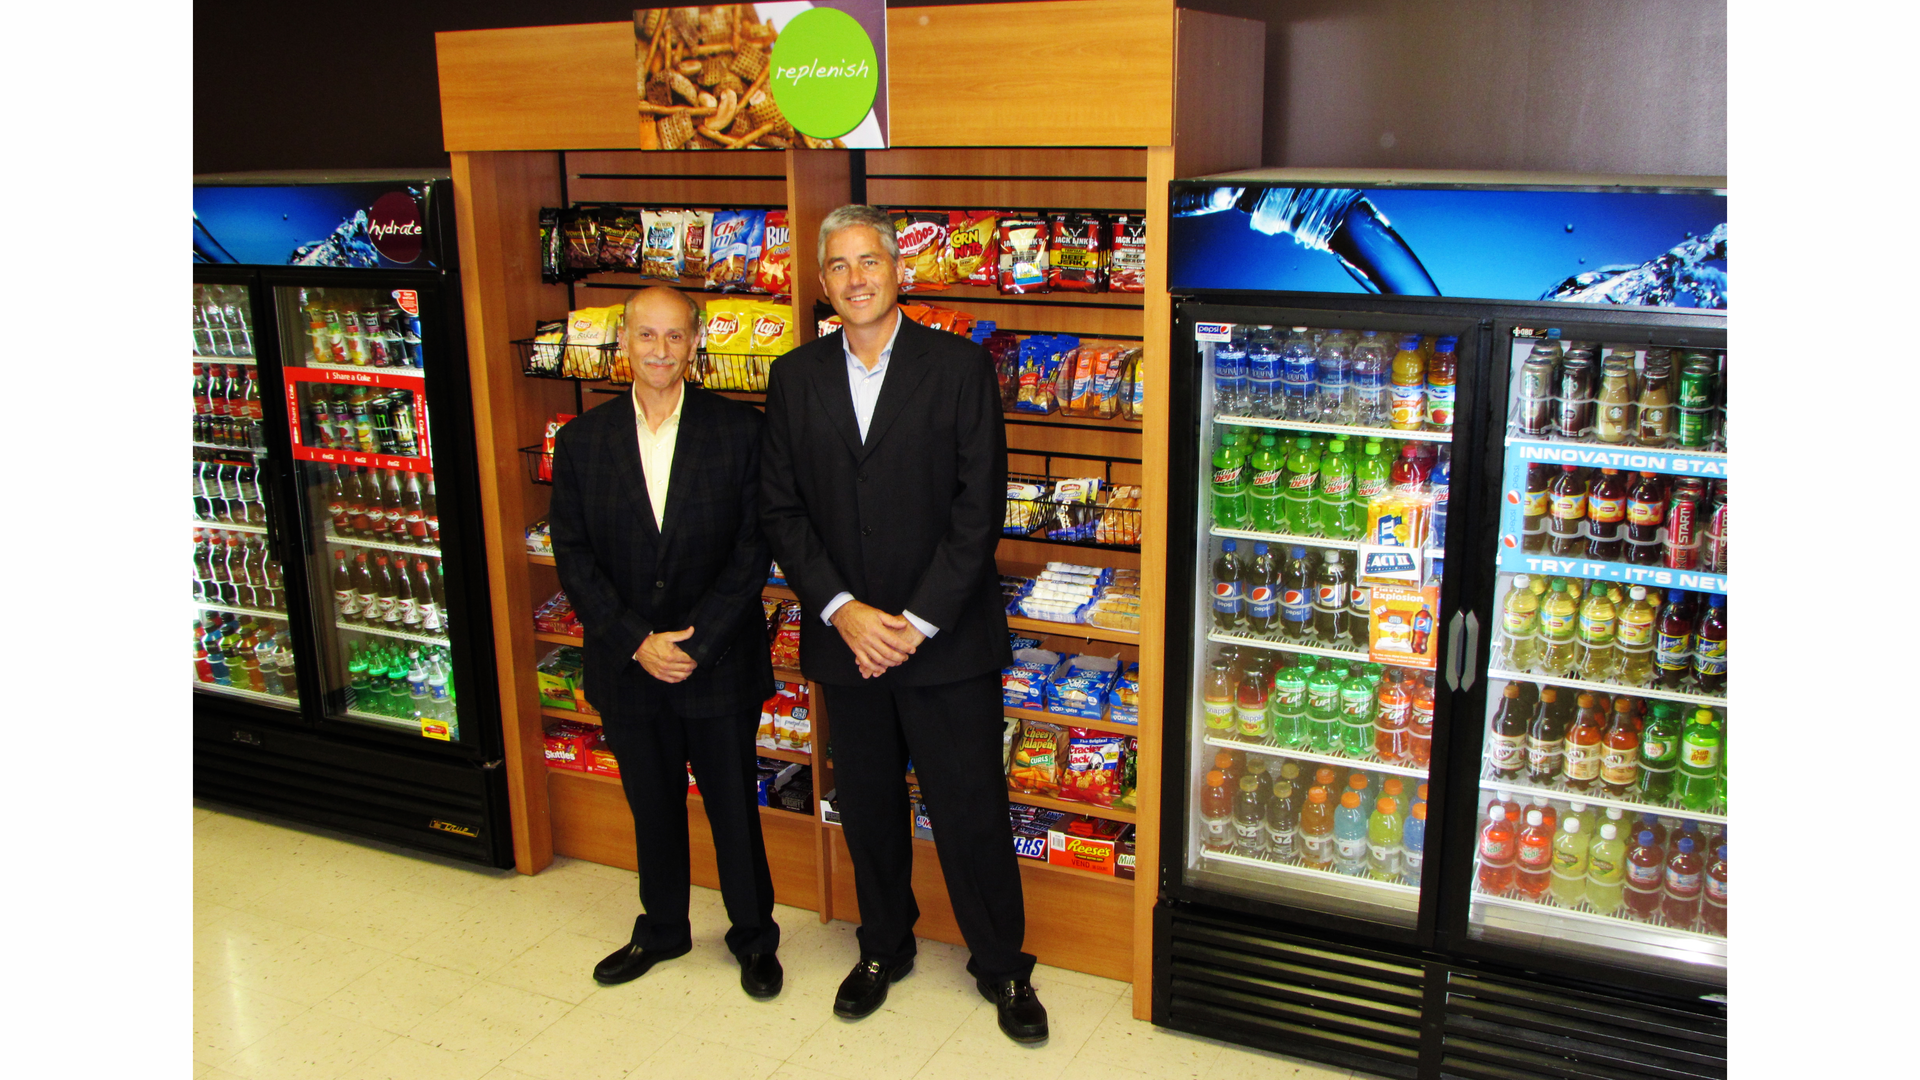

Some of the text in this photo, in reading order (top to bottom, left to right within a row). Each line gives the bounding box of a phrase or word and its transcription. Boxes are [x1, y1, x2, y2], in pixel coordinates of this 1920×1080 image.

[776, 58, 869, 86] replenish
[368, 220, 423, 240] hydrate
[714, 218, 747, 237] Chex
[897, 226, 935, 250] ombos
[708, 316, 738, 335] Lay's
[755, 318, 786, 336] Lay's
[1198, 324, 1219, 334] pepsi
[708, 344, 731, 352] Classic
[332, 372, 351, 381] Share
[356, 374, 372, 382] Coke
[1519, 446, 1666, 470] INNOVATION
[1512, 464, 1521, 489] pepsi
[1508, 508, 1518, 533] pepsi
[1371, 556, 1395, 567] ACT
[1526, 558, 1577, 574] TRY
[1582, 563, 1606, 577] IT
[1625, 568, 1675, 585] IT'S
[1372, 591, 1424, 602] Explosion
[1374, 605, 1388, 616] NEW
[1024, 726, 1056, 741] Cheesy
[545, 750, 576, 761] Skittles
[1069, 745, 1105, 754] Cracker
[1030, 756, 1049, 764] CURLS
[1069, 754, 1091, 764] Jack
[1067, 839, 1112, 857] Reese's
[1071, 859, 1091, 869] VEND
